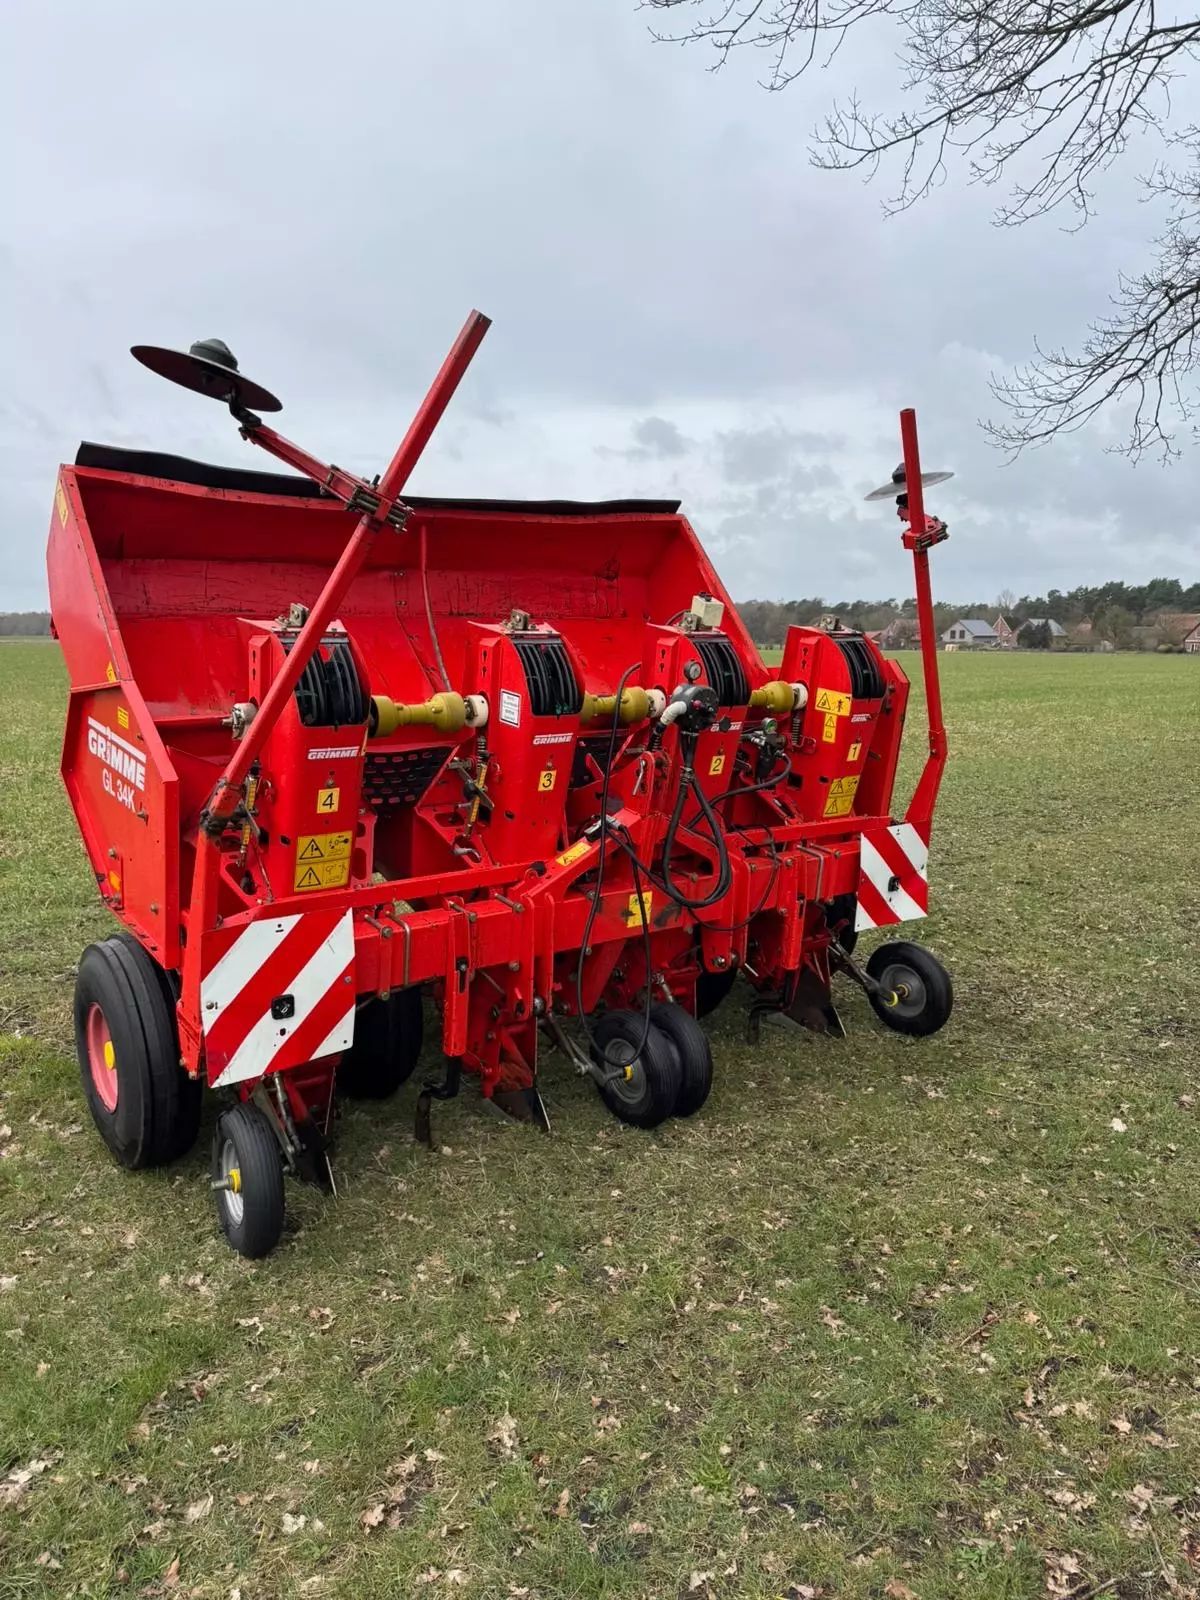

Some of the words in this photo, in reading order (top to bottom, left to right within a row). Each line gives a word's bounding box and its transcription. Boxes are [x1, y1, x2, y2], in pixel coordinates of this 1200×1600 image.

[712, 758, 722, 772] 2
[542, 772, 553, 788] 3
[102, 768, 116, 797] GL
[116, 779, 136, 813] 34K
[322, 792, 335, 809] 4
